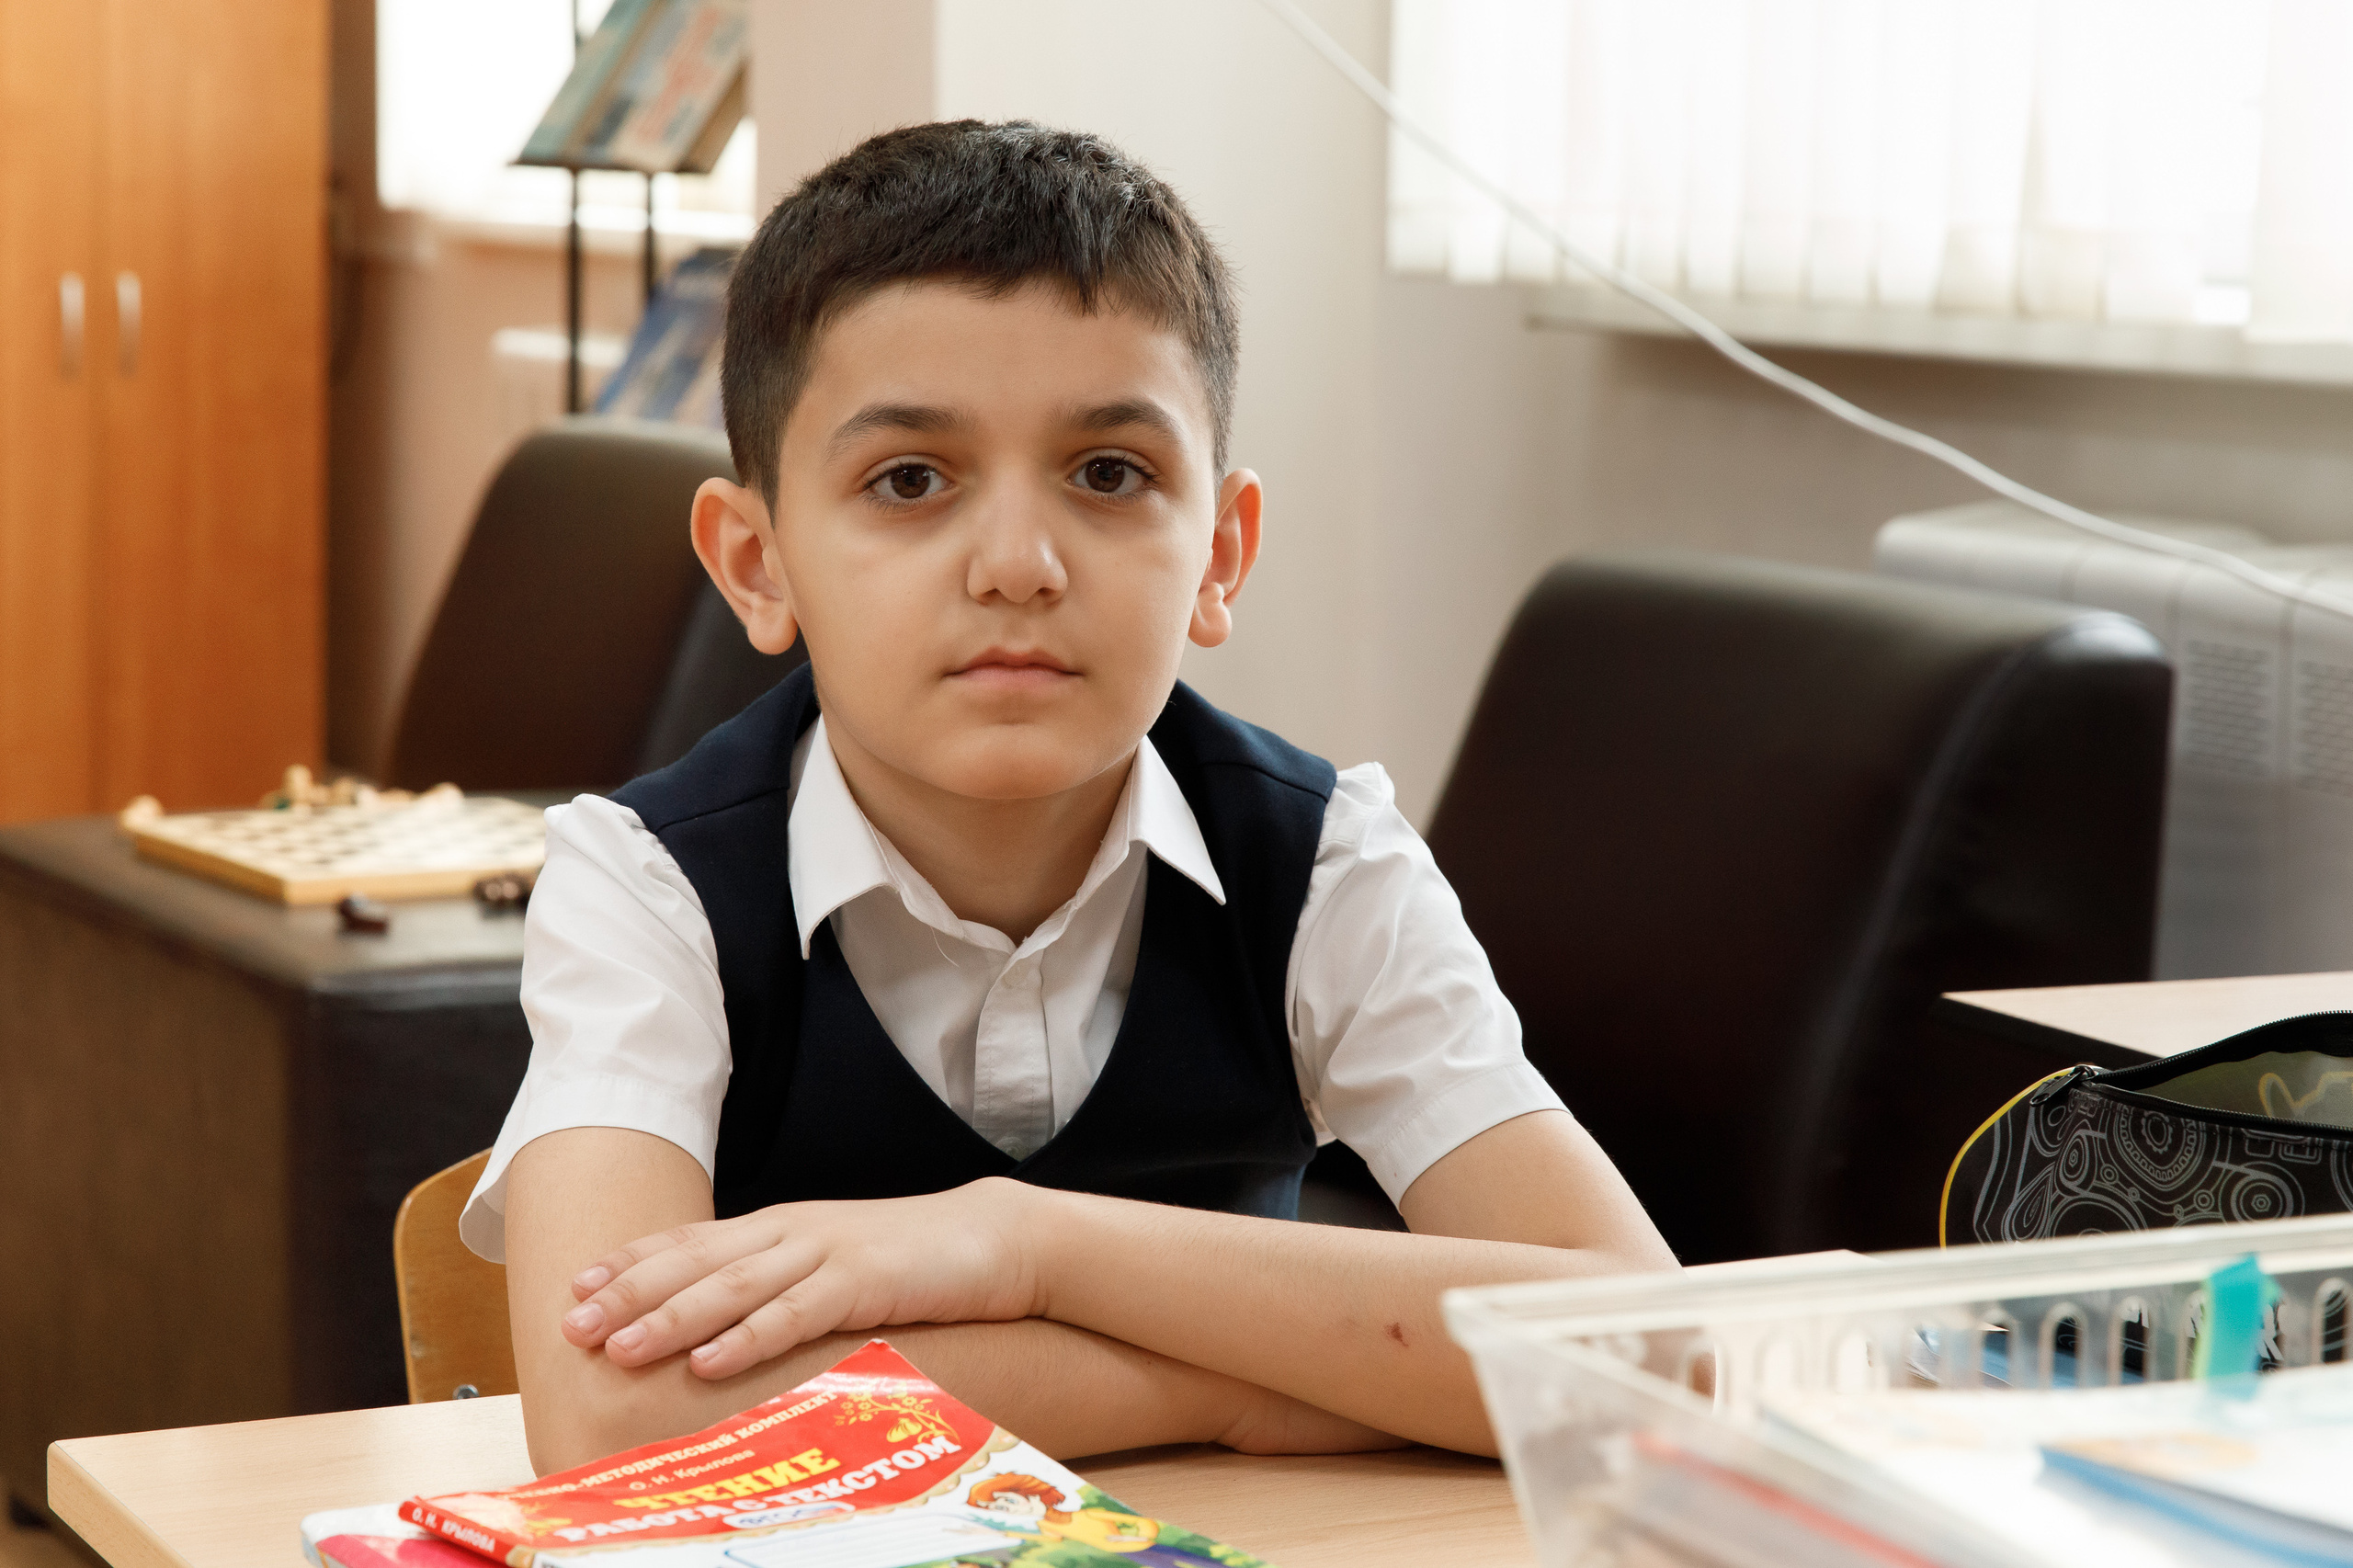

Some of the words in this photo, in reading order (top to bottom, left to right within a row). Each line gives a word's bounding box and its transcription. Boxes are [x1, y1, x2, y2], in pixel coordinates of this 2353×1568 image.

[734, 1390, 838, 1440] КОМПЛЕКТ
[553, 1504, 737, 1542] РАБОТА
[762, 1435, 962, 1506] ТЕКСТОМ
[612, 1447, 841, 1509] ЧТЕНИЕ
[673, 1449, 756, 1480] Крылова
[441, 1518, 496, 1553] КРЫЛОВА
